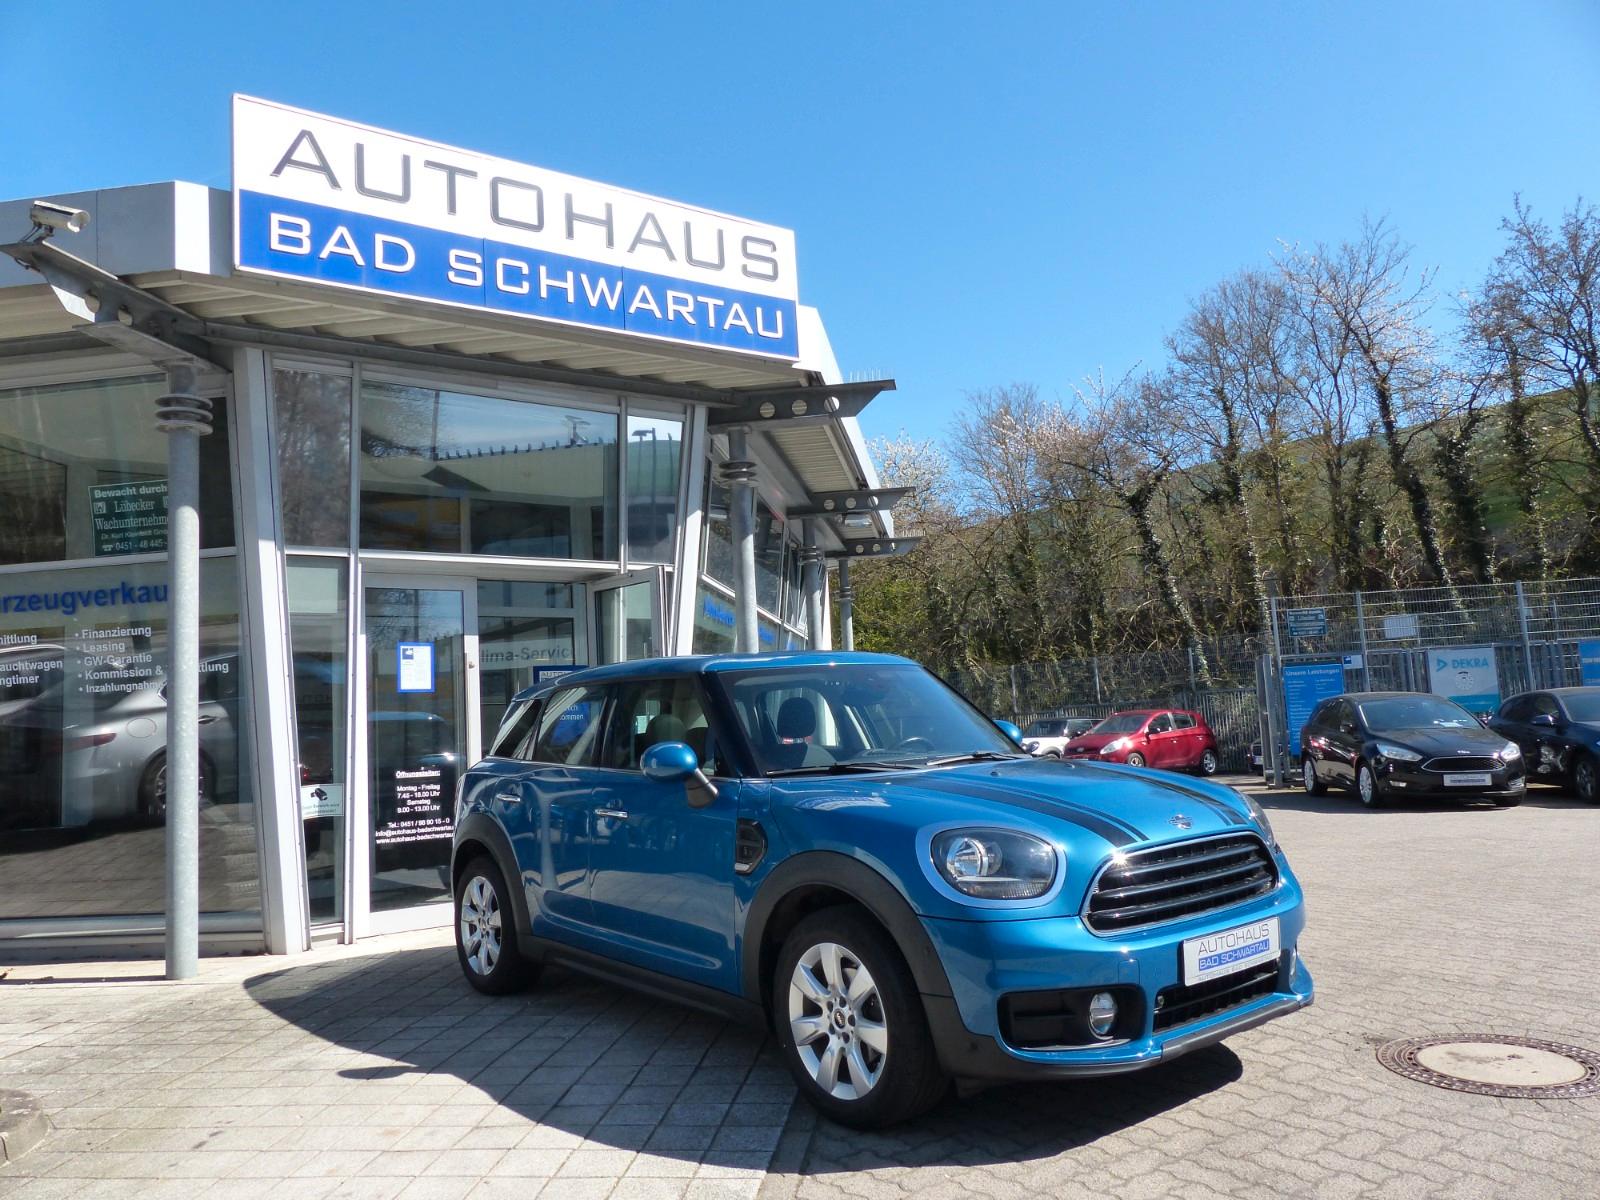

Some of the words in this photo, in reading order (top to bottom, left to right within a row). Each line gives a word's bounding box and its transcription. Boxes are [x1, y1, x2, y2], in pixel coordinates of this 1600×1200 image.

[268, 128, 779, 283] AUTOHAUS
[270, 212, 416, 273] BAD
[447, 248, 784, 340] SCHWARTAU
[94, 487, 137, 499] Bewacht
[139, 484, 168, 495] durch
[113, 499, 155, 513] Lübecker
[81, 626, 152, 639] Finanzierung
[83, 642, 126, 653] Leasing
[84, 653, 152, 666] GW-Garantie
[1452, 657, 1489, 670] DEKRA
[85, 667, 151, 680] Kommission
[155, 664, 163, 675] &
[1198, 923, 1270, 955] AUTOHAUS
[1200, 956, 1219, 969] BAD
[1220, 939, 1269, 964] SCHWARTAU
